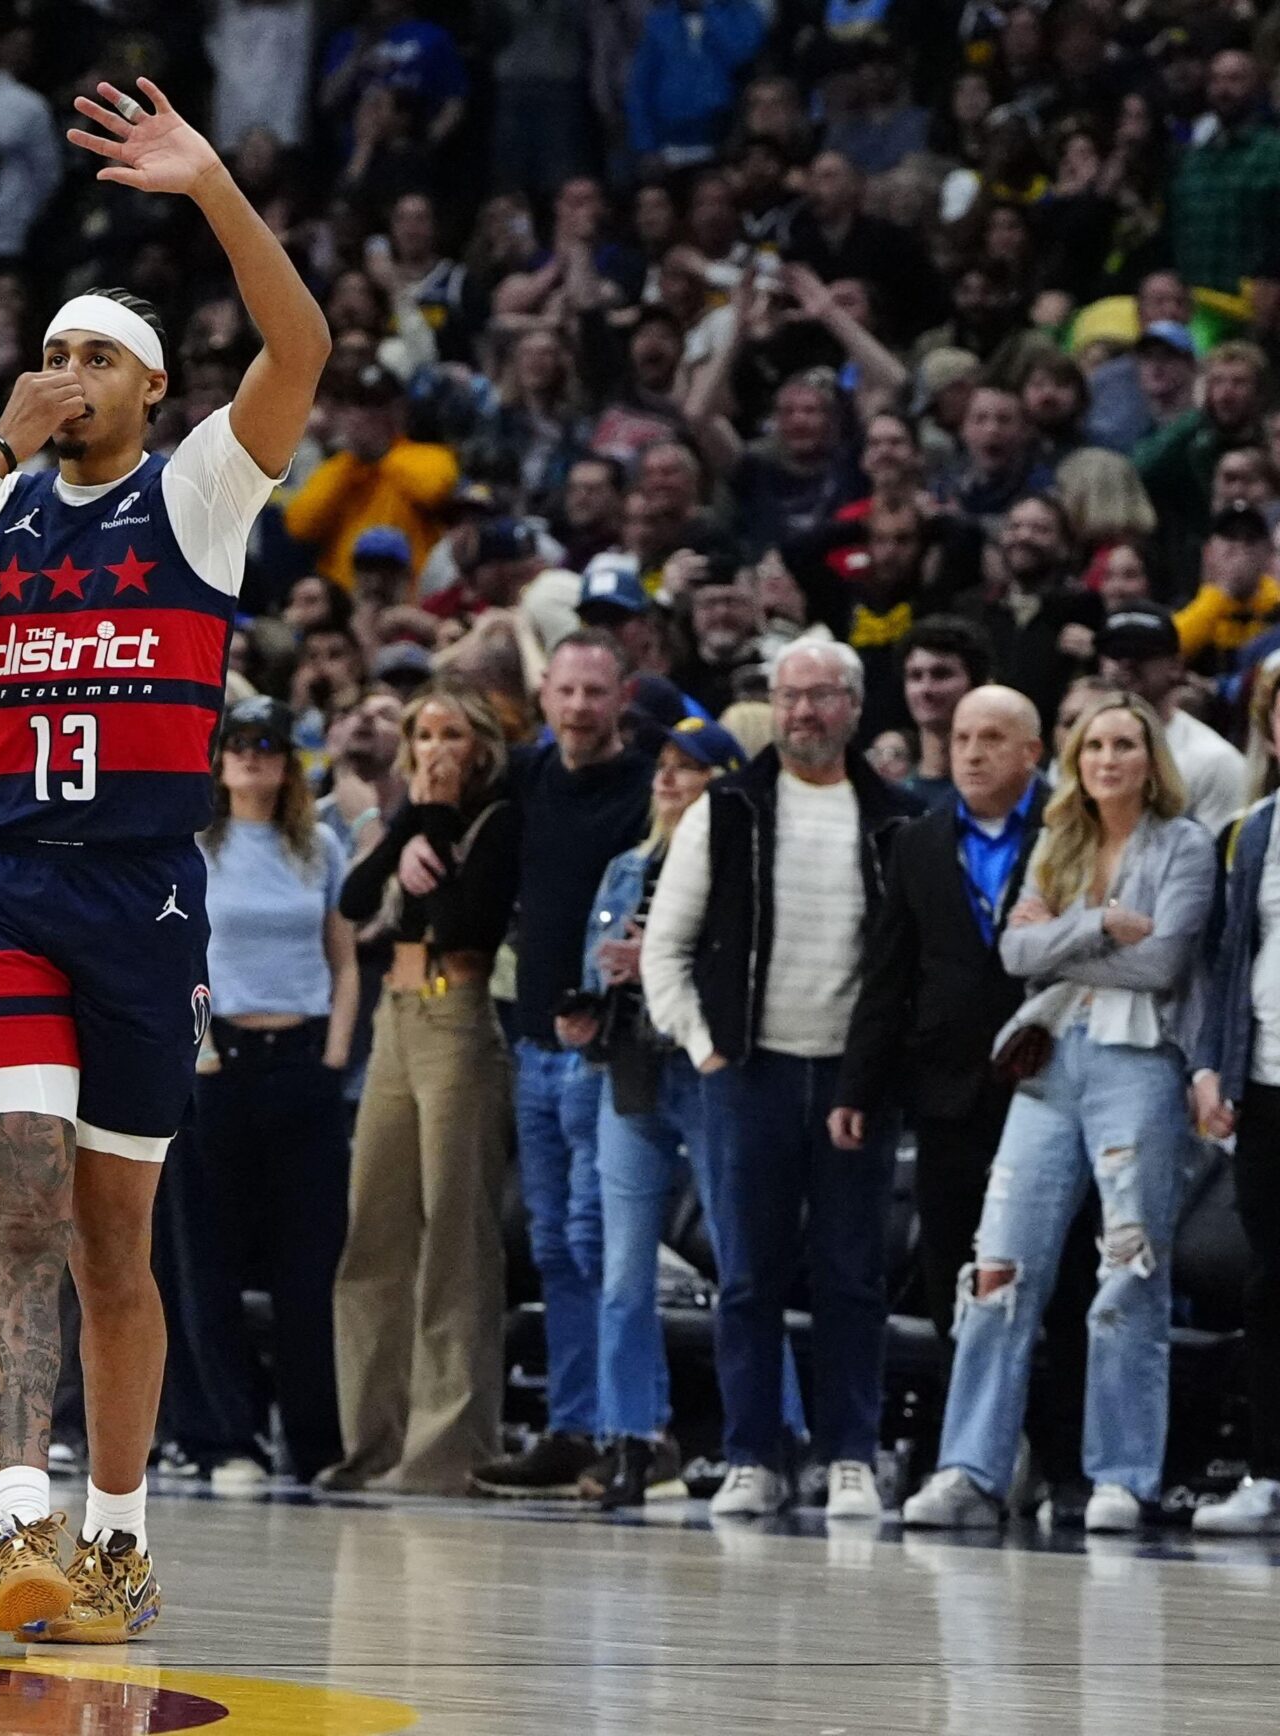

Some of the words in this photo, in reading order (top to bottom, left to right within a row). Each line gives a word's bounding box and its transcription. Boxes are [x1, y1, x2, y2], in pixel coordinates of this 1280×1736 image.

[101, 513, 150, 530] Robinhood
[26, 627, 56, 640] THE
[21, 685, 153, 698] COLUMBIA
[30, 714, 97, 801] 13
